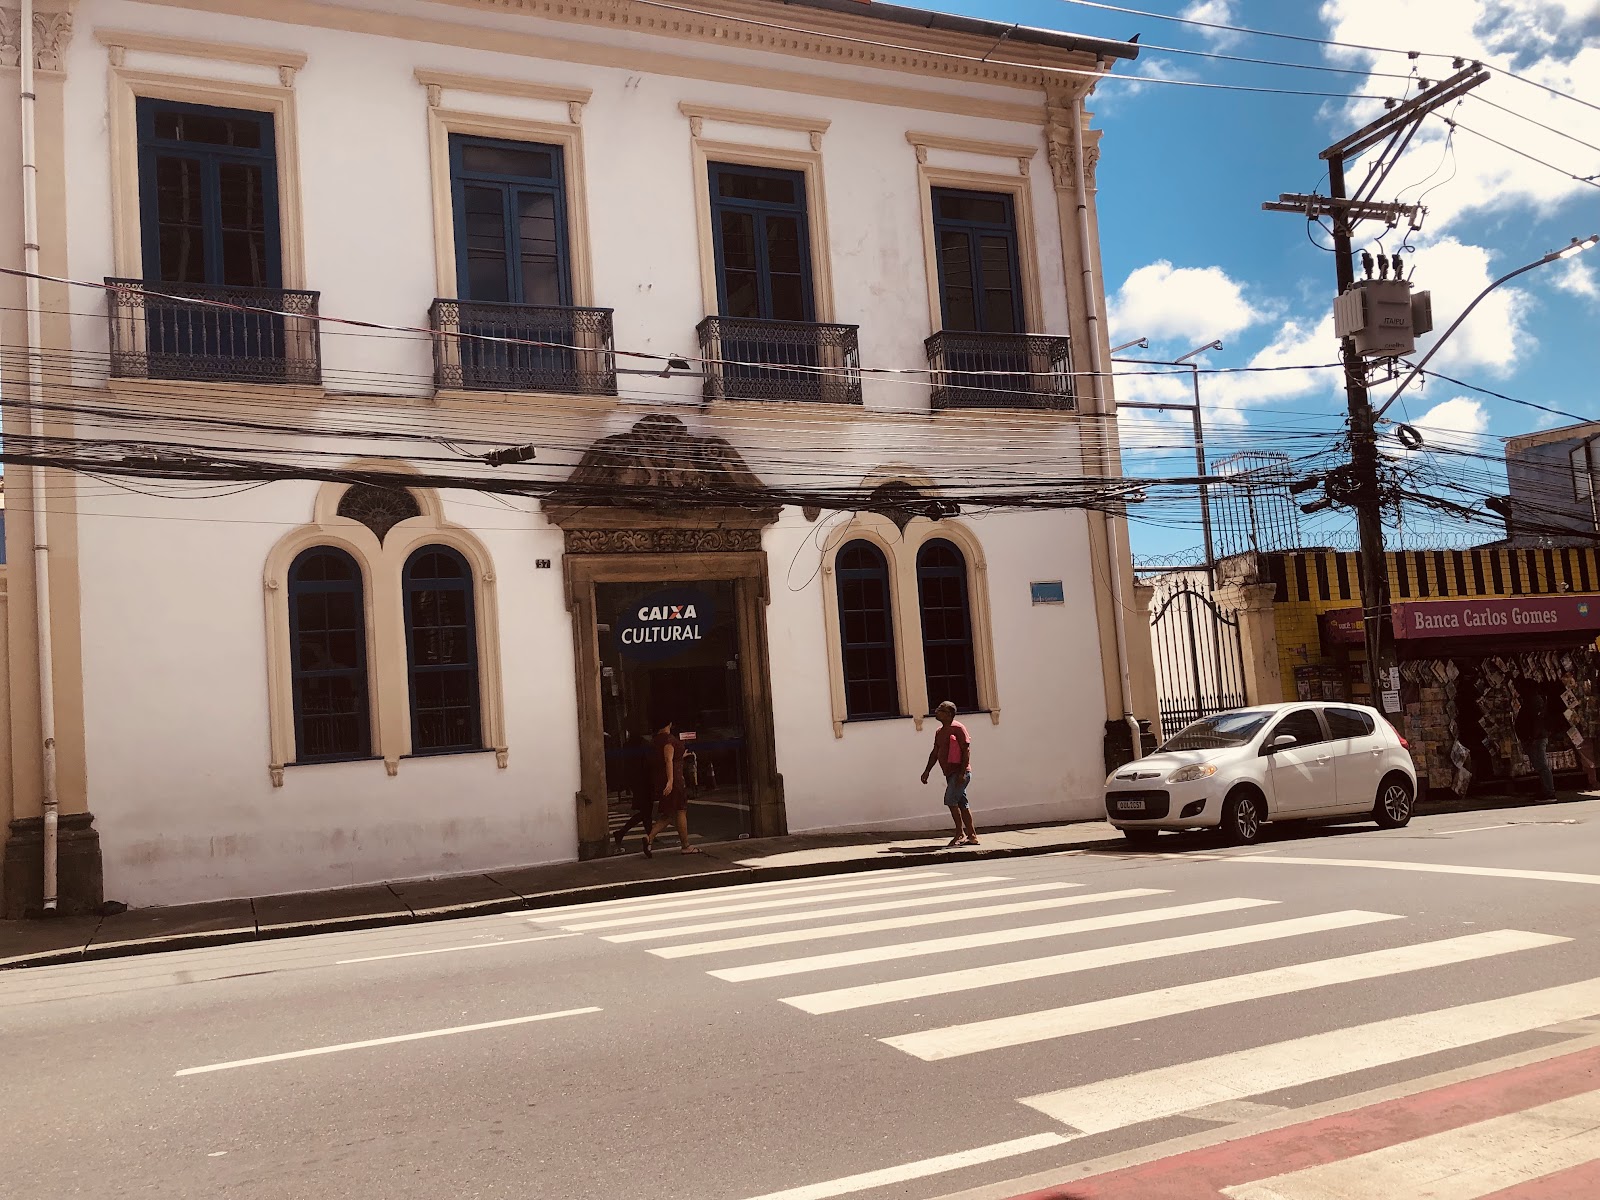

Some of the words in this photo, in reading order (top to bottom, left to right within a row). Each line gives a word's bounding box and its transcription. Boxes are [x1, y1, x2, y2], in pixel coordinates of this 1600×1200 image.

[1384, 317, 1405, 326] ITAIPU
[638, 604, 697, 621] CAIXA
[1413, 611, 1460, 630] Banca
[1463, 607, 1508, 627] Carlos
[1511, 607, 1558, 625] Gomes
[621, 624, 702, 644] CULTURAL
